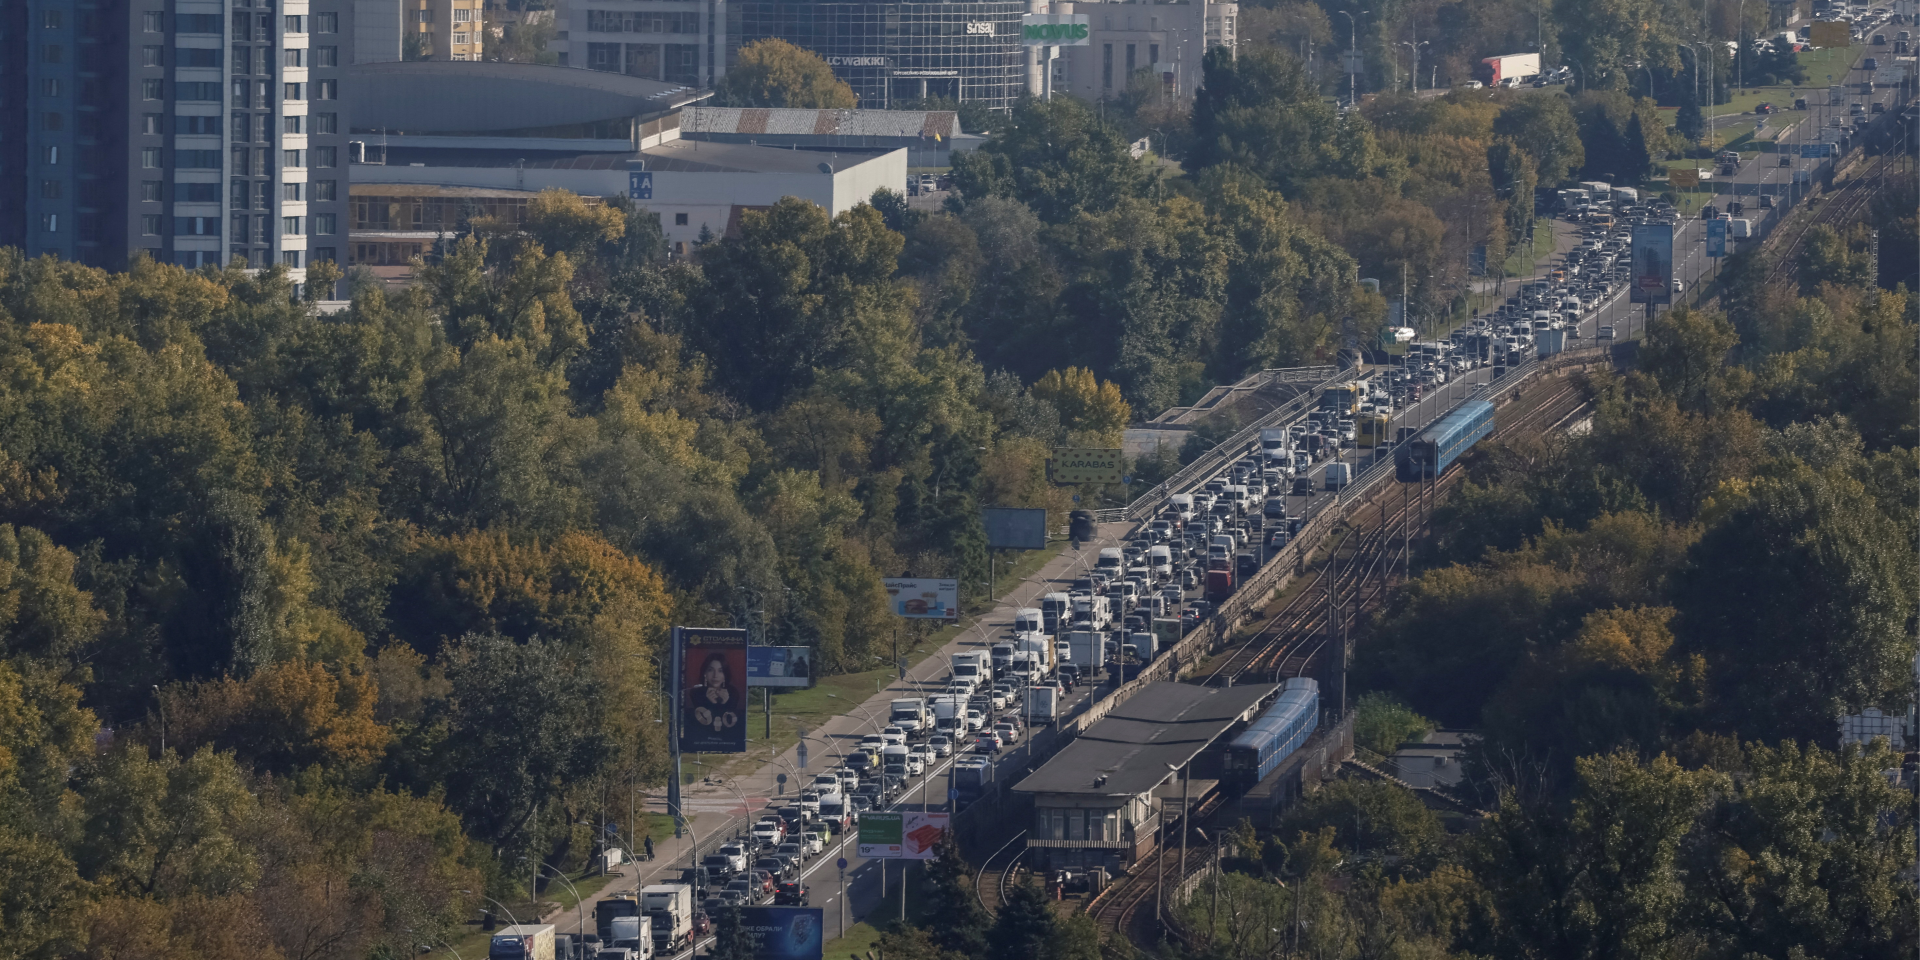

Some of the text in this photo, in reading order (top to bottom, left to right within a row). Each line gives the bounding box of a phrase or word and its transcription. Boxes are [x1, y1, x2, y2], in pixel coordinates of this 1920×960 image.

[967, 20, 995, 37] sinsay
[1023, 24, 1088, 40] NOVUS
[1061, 460, 1115, 468] KARABAS
